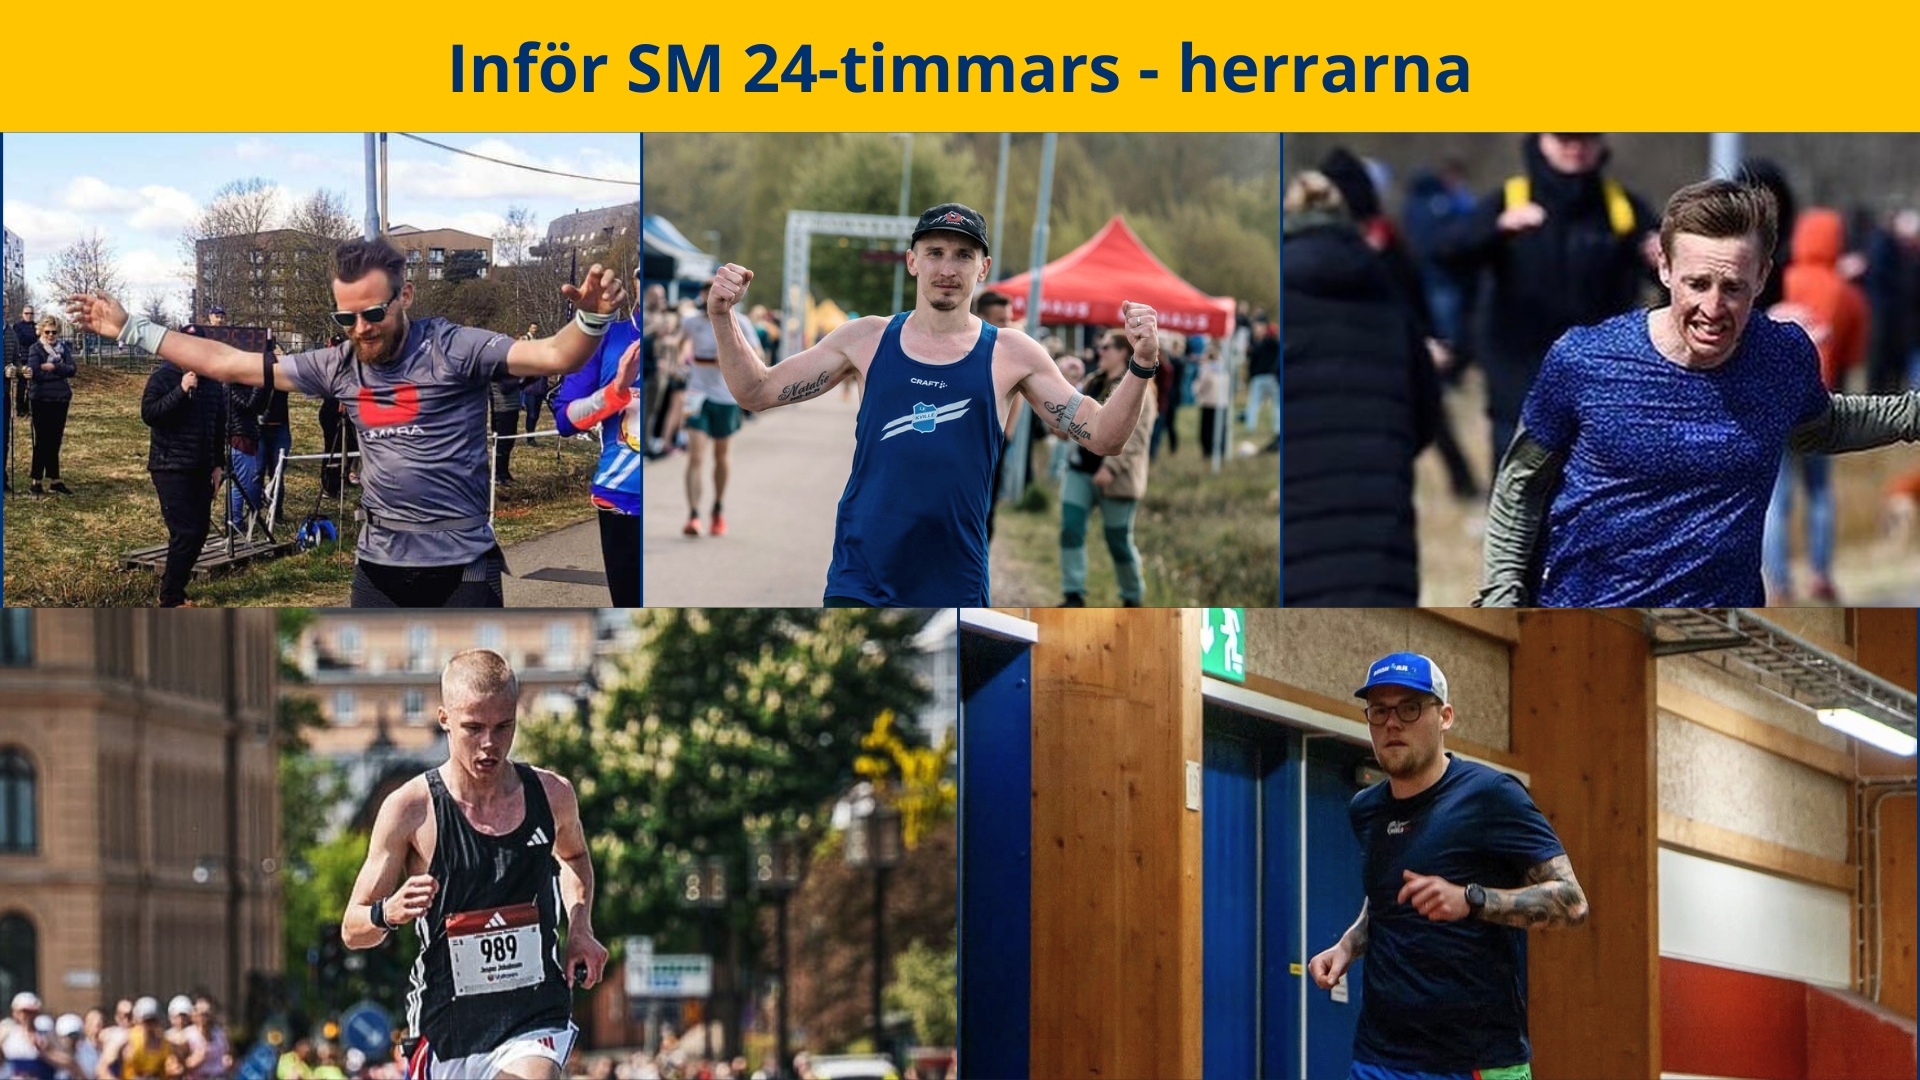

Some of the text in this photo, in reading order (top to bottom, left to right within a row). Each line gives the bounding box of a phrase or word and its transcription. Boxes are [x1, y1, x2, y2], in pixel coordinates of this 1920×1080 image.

[778, 370, 829, 401] Natalie
[910, 377, 940, 387] CRAFT
[915, 412, 936, 421] KVILLE
[480, 934, 517, 963] 989
